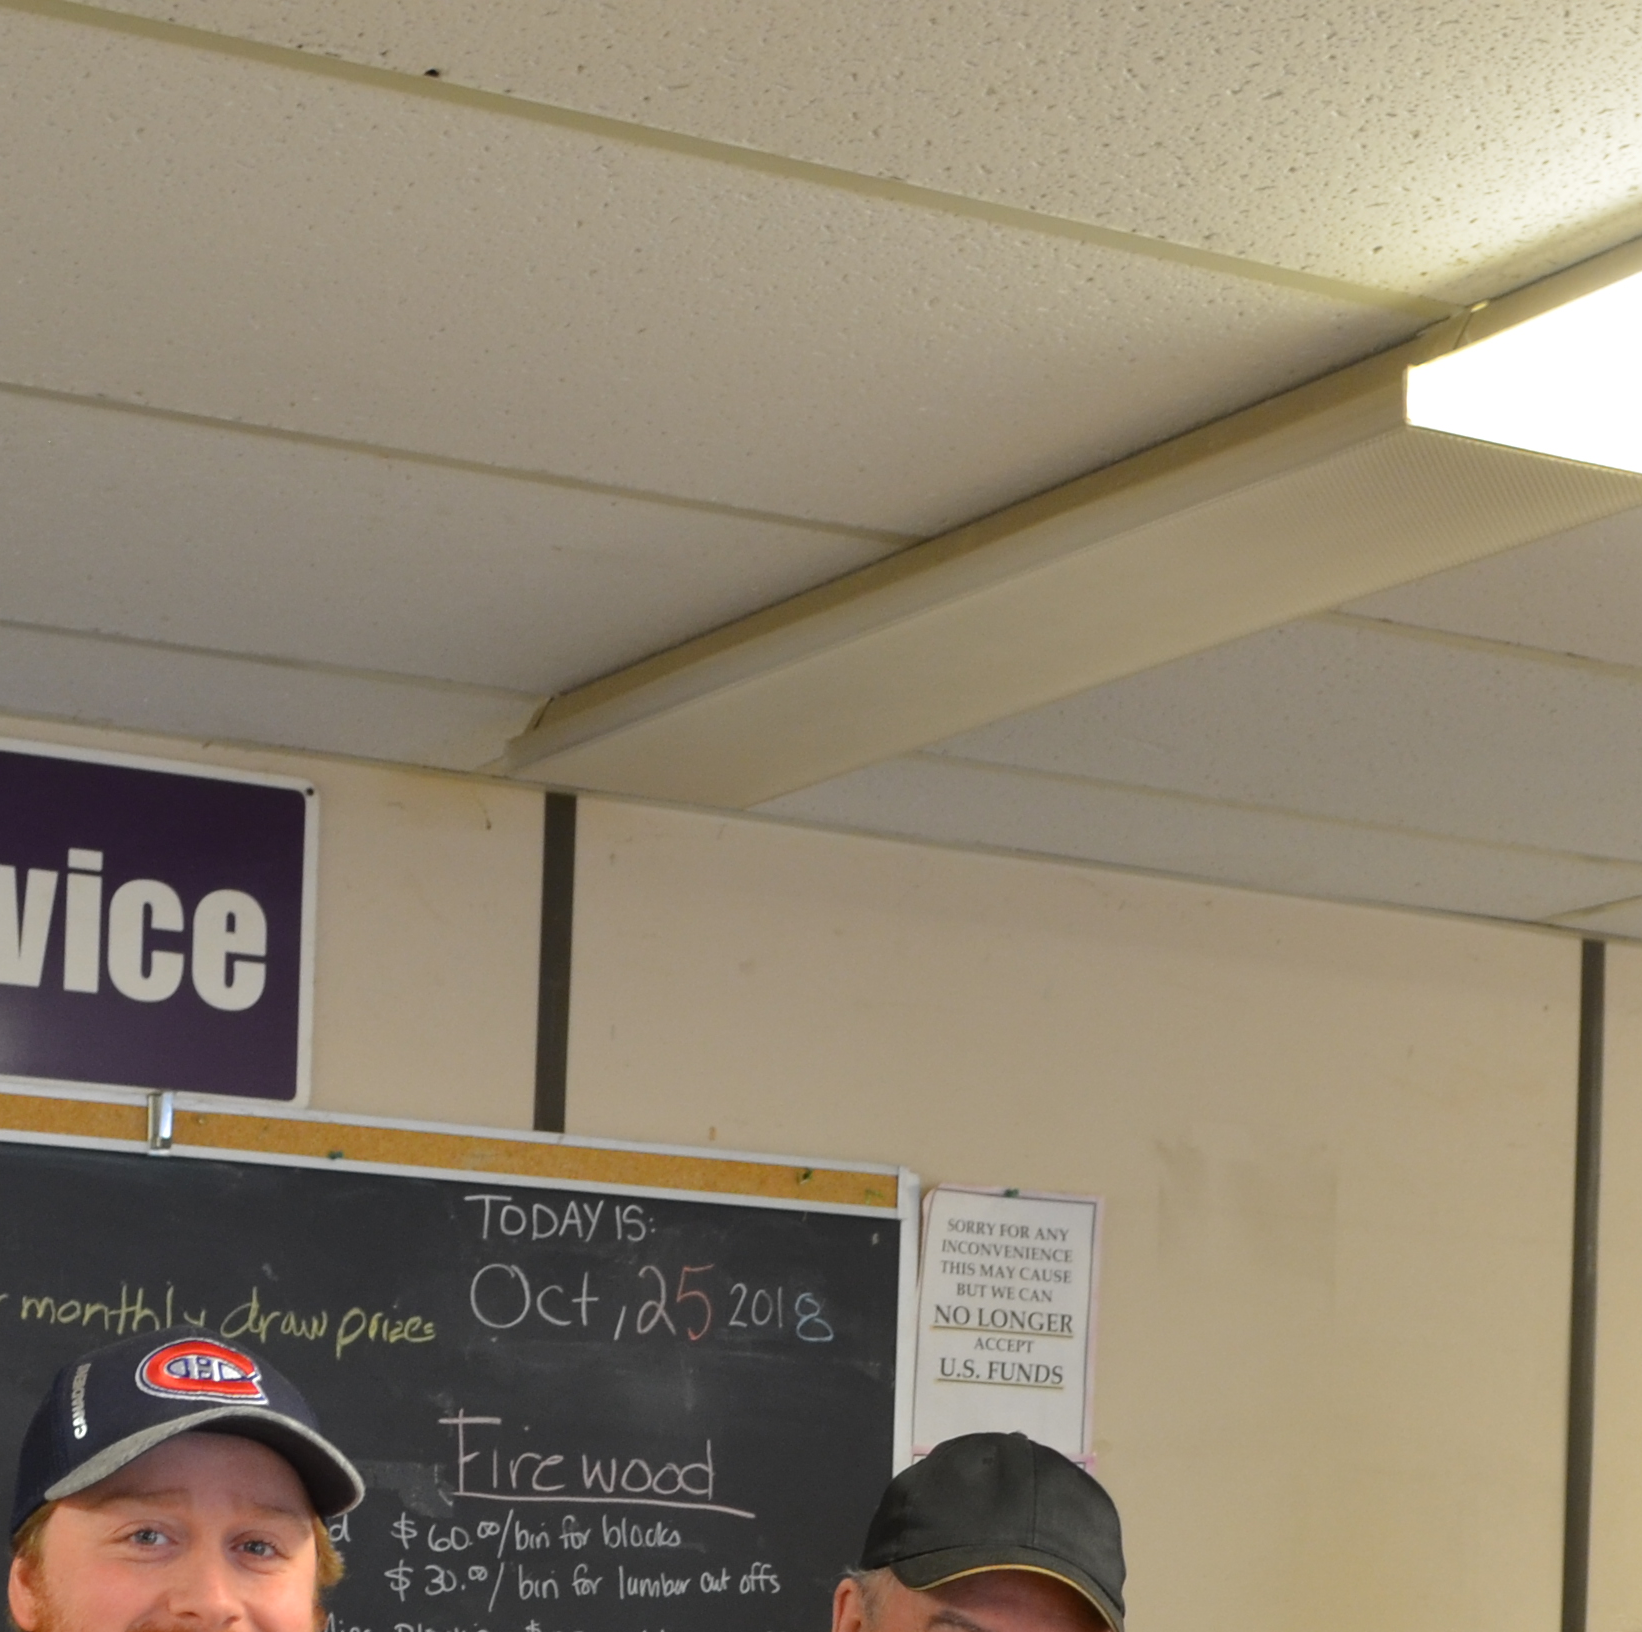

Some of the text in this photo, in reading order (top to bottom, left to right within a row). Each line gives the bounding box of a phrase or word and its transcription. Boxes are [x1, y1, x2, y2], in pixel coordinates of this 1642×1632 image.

[464, 1195, 657, 1242] TODAY IS:
[947, 1218, 1070, 1243] SORRY FOR ANY
[941, 1239, 1073, 1263] INCONVENIENCE
[941, 1260, 1072, 1284] THIS MAY CAUSE
[956, 1283, 1053, 1303] BUT WE CAN
[20, 1281, 209, 1334] monthly
[221, 1286, 328, 1343] draw
[729, 1282, 834, 1342] 2018
[934, 1304, 1073, 1334] NO LONGER
[973, 1337, 1034, 1354] ACCEPT
[939, 1357, 1063, 1385] U.S. FUNDS
[601, 1513, 681, 1549] blocks
